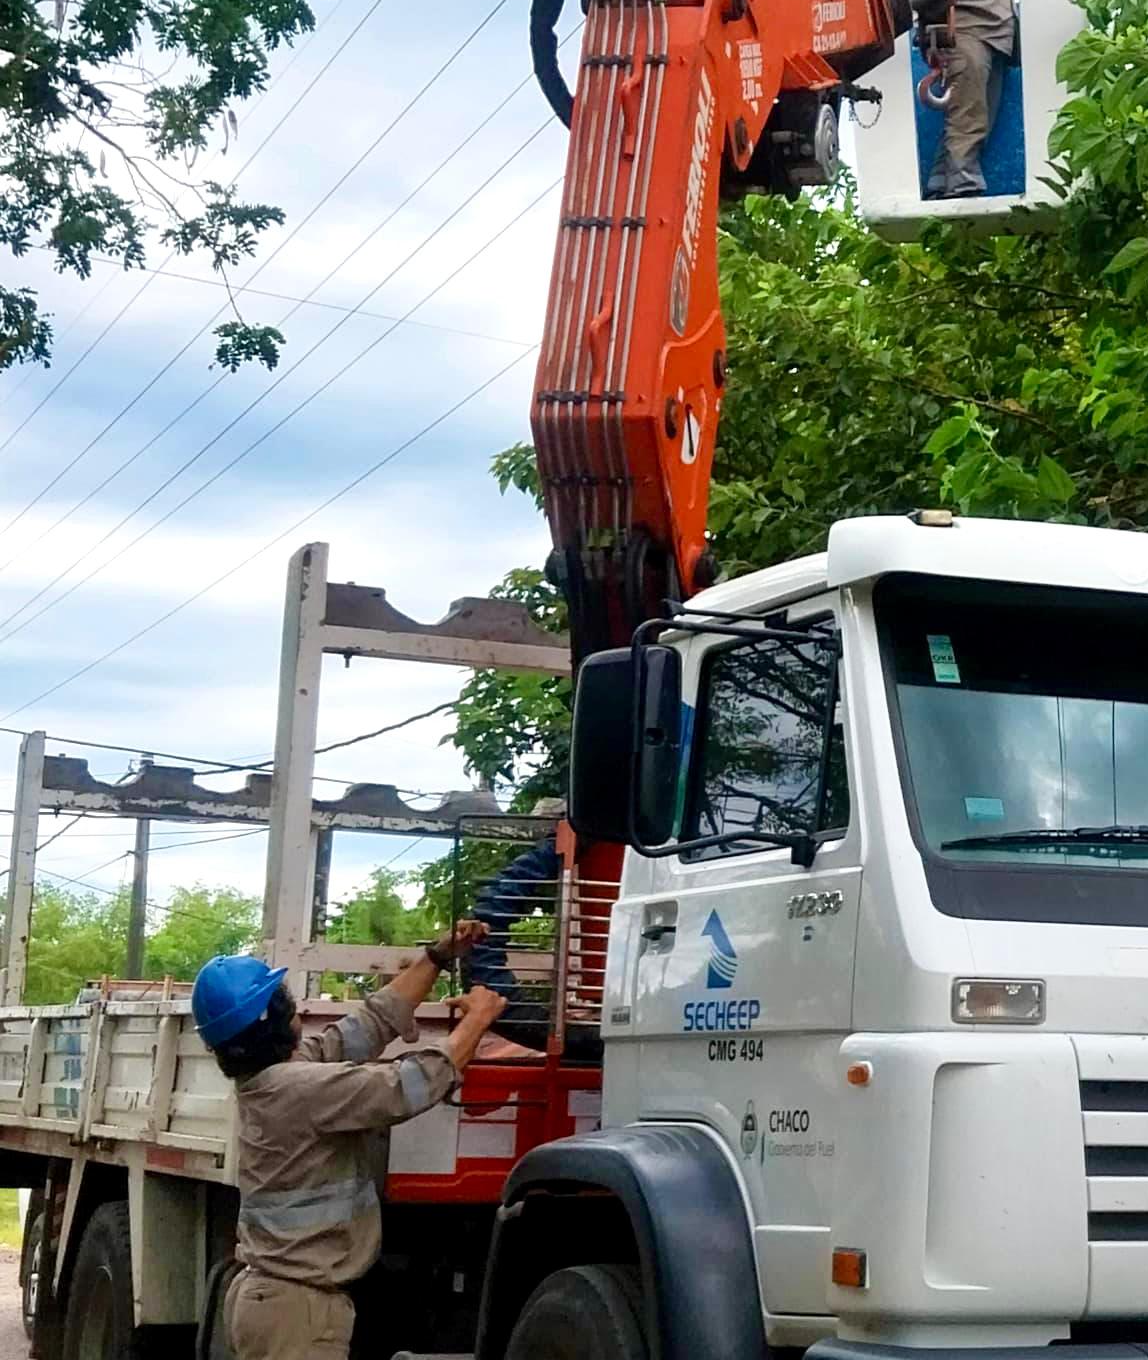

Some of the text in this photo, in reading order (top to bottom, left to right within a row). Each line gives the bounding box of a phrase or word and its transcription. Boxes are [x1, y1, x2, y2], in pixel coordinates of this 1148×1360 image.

[684, 1000, 760, 1031] SECHEEP
[708, 1040, 764, 1062] CMG 494
[769, 1110, 810, 1133] CHACO
